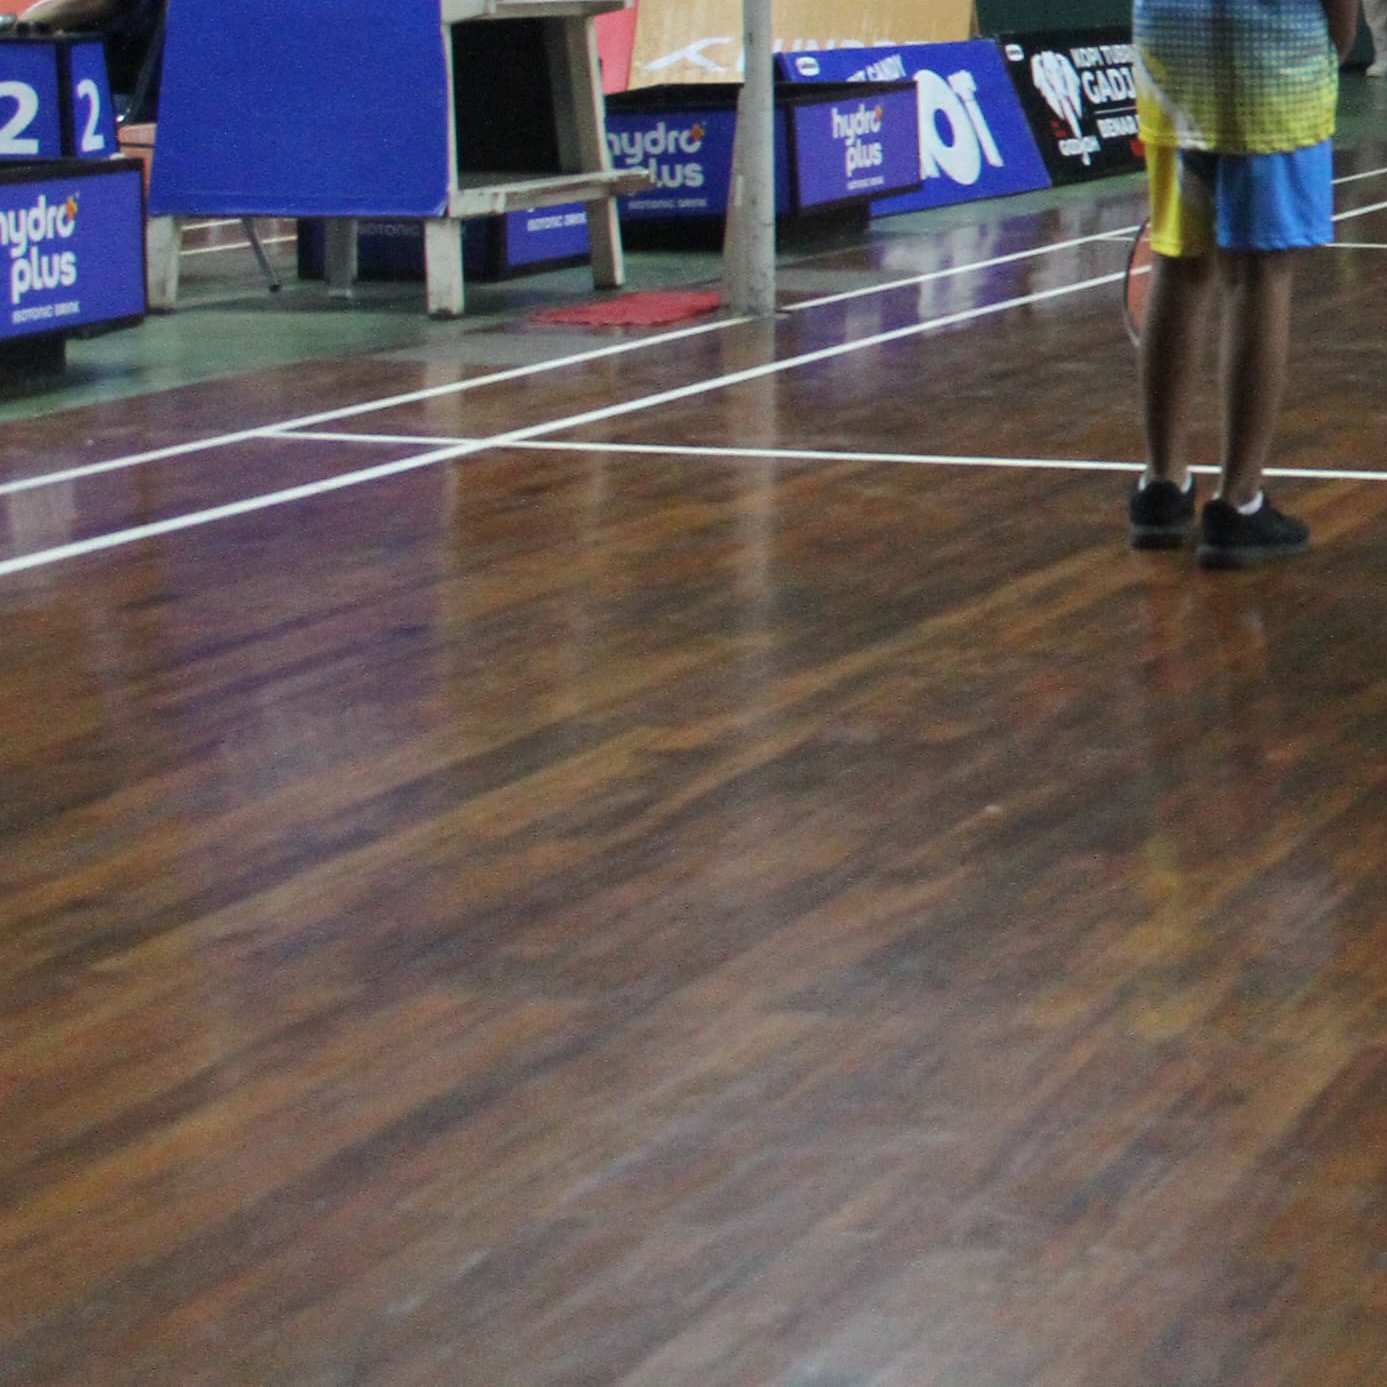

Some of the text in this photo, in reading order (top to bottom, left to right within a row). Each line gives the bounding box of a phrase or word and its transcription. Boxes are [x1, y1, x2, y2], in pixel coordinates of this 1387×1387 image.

[0, 80, 39, 154] 2
[77, 78, 104, 152] 2
[832, 103, 882, 145] hydro
[846, 139, 883, 177] plus
[11, 246, 77, 305] plus
